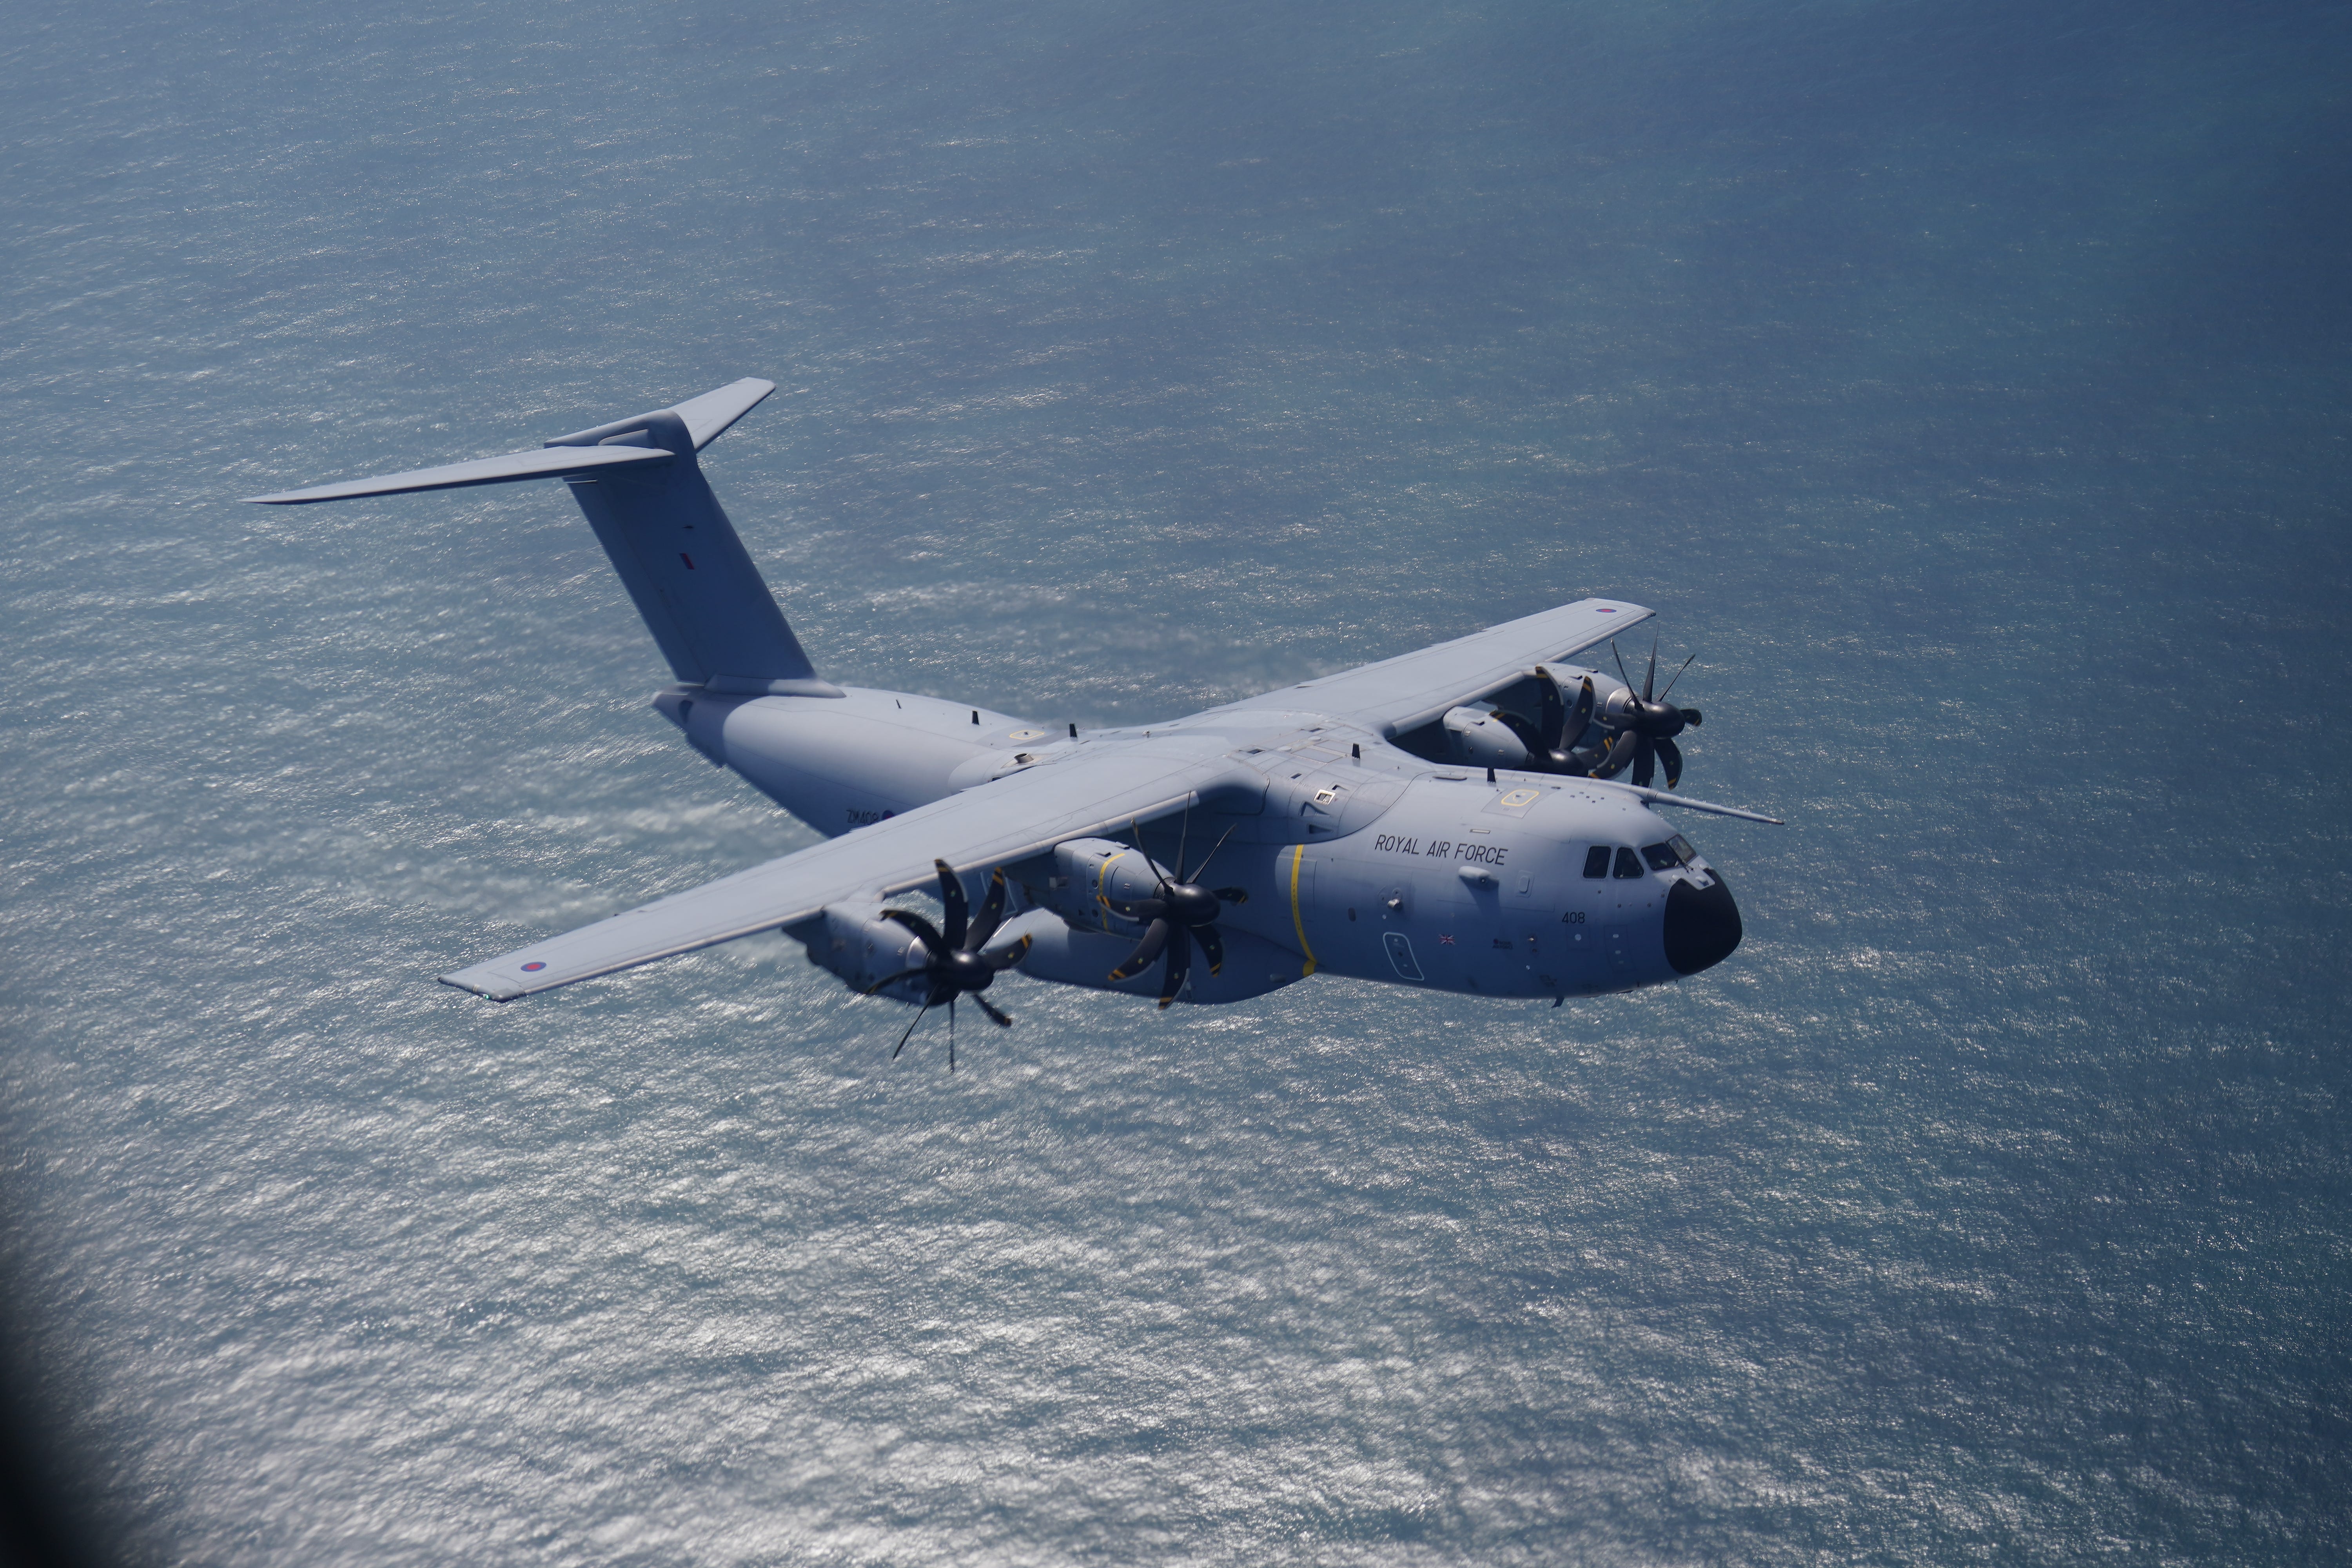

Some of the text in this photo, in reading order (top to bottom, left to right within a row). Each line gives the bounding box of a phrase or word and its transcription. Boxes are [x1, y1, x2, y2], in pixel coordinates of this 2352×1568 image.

[1374, 835, 1508, 865] ROYAL AIR FORCE
[1562, 912, 1585, 924] 408
